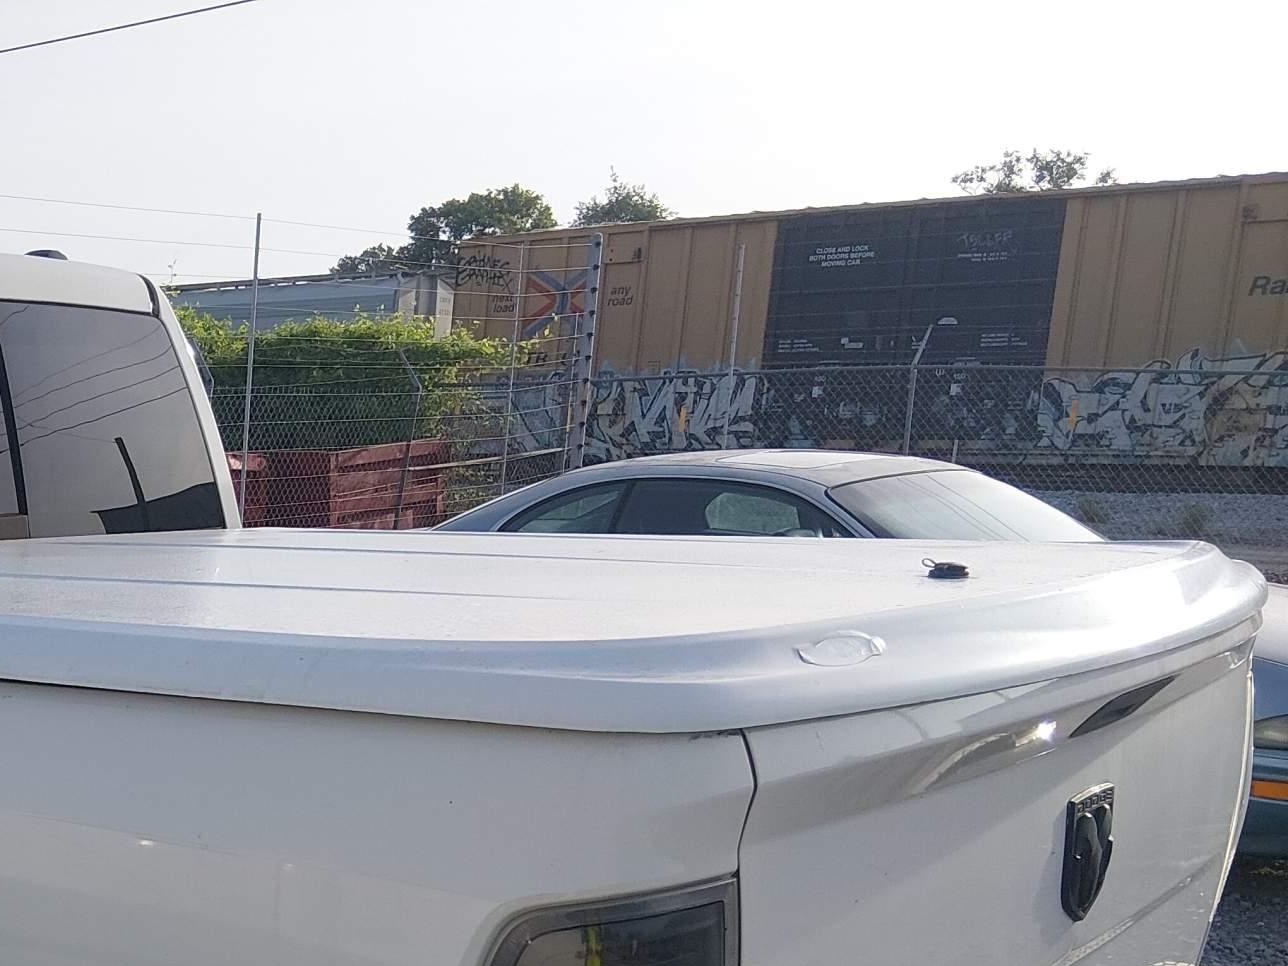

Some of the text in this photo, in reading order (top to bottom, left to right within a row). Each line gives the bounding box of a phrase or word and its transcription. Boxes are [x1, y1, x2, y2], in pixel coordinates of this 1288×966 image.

[808, 254, 826, 262] BOTH
[611, 286, 631, 297] any
[1247, 276, 1288, 296] Ra
[607, 295, 634, 306] road
[493, 303, 515, 313] load
